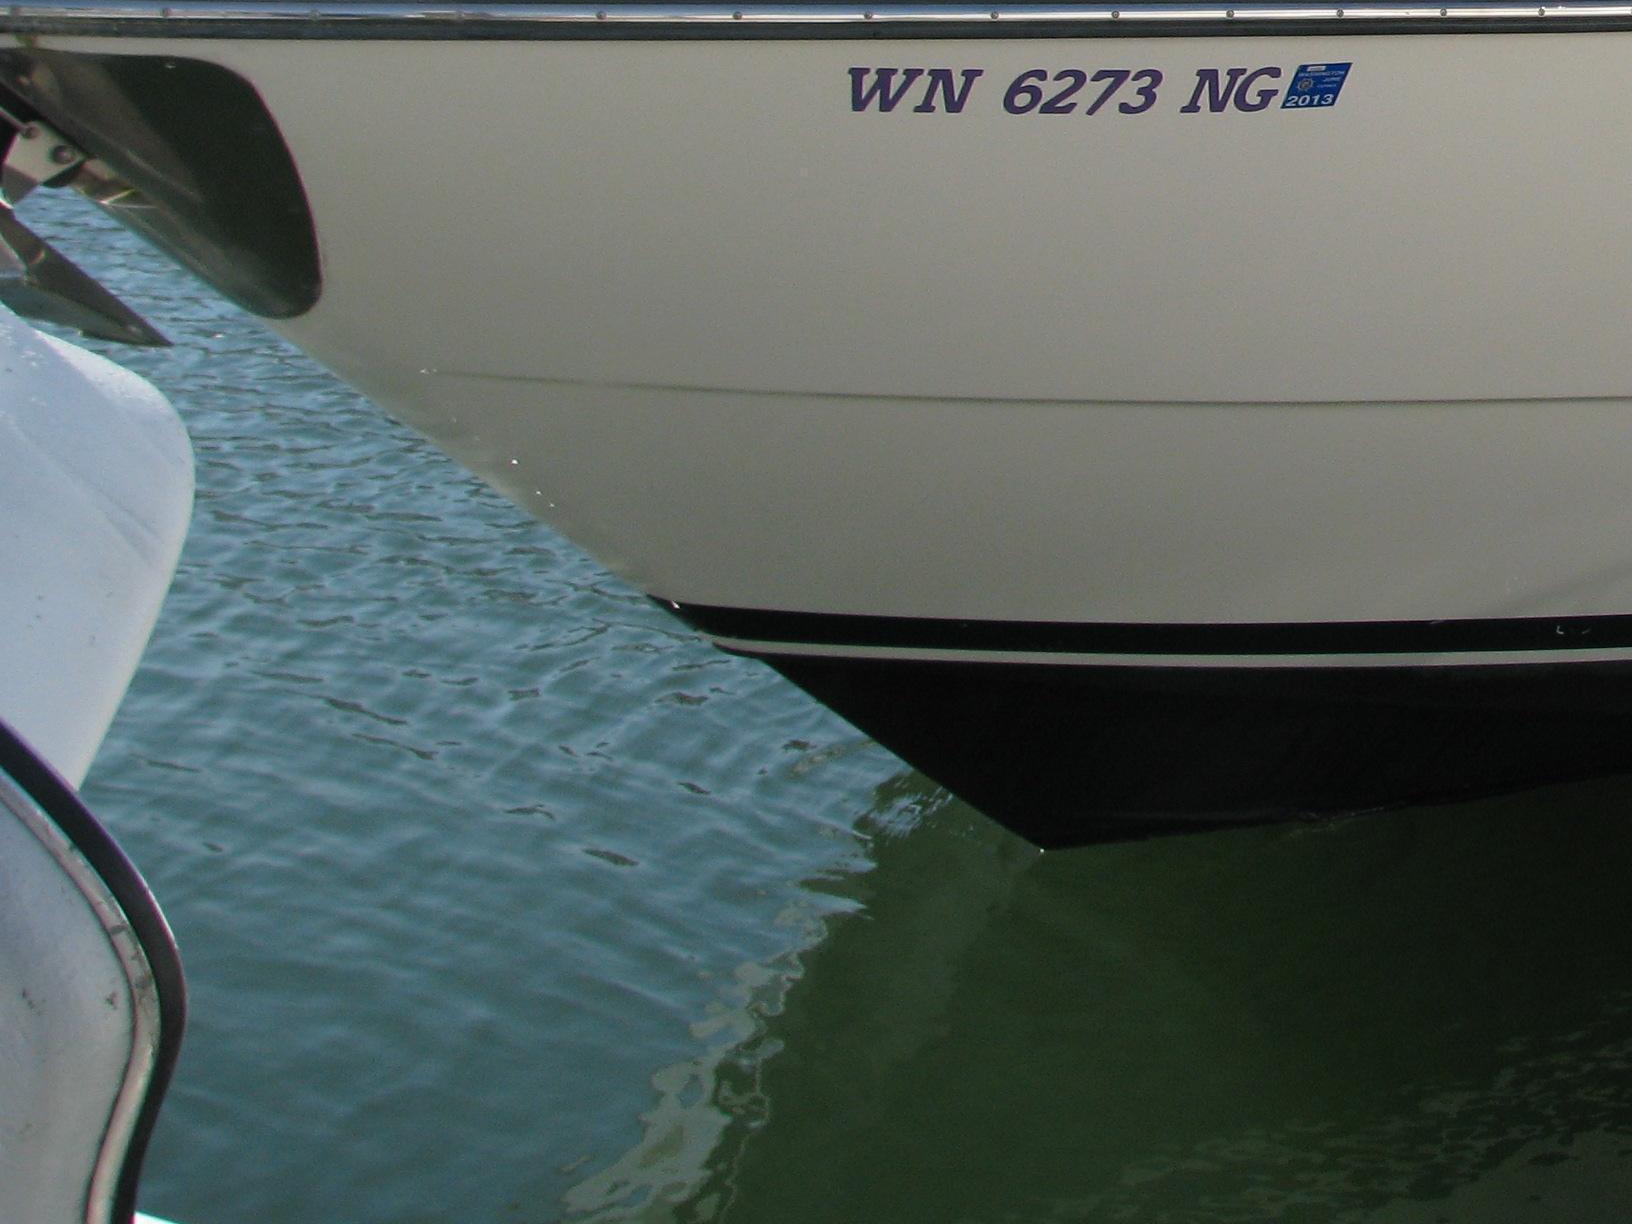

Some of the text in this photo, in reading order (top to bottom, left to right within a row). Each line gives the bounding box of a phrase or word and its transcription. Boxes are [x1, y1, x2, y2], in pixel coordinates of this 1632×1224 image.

[847, 66, 1282, 116] WN 6273 NG
[1285, 93, 1334, 107] 2013
